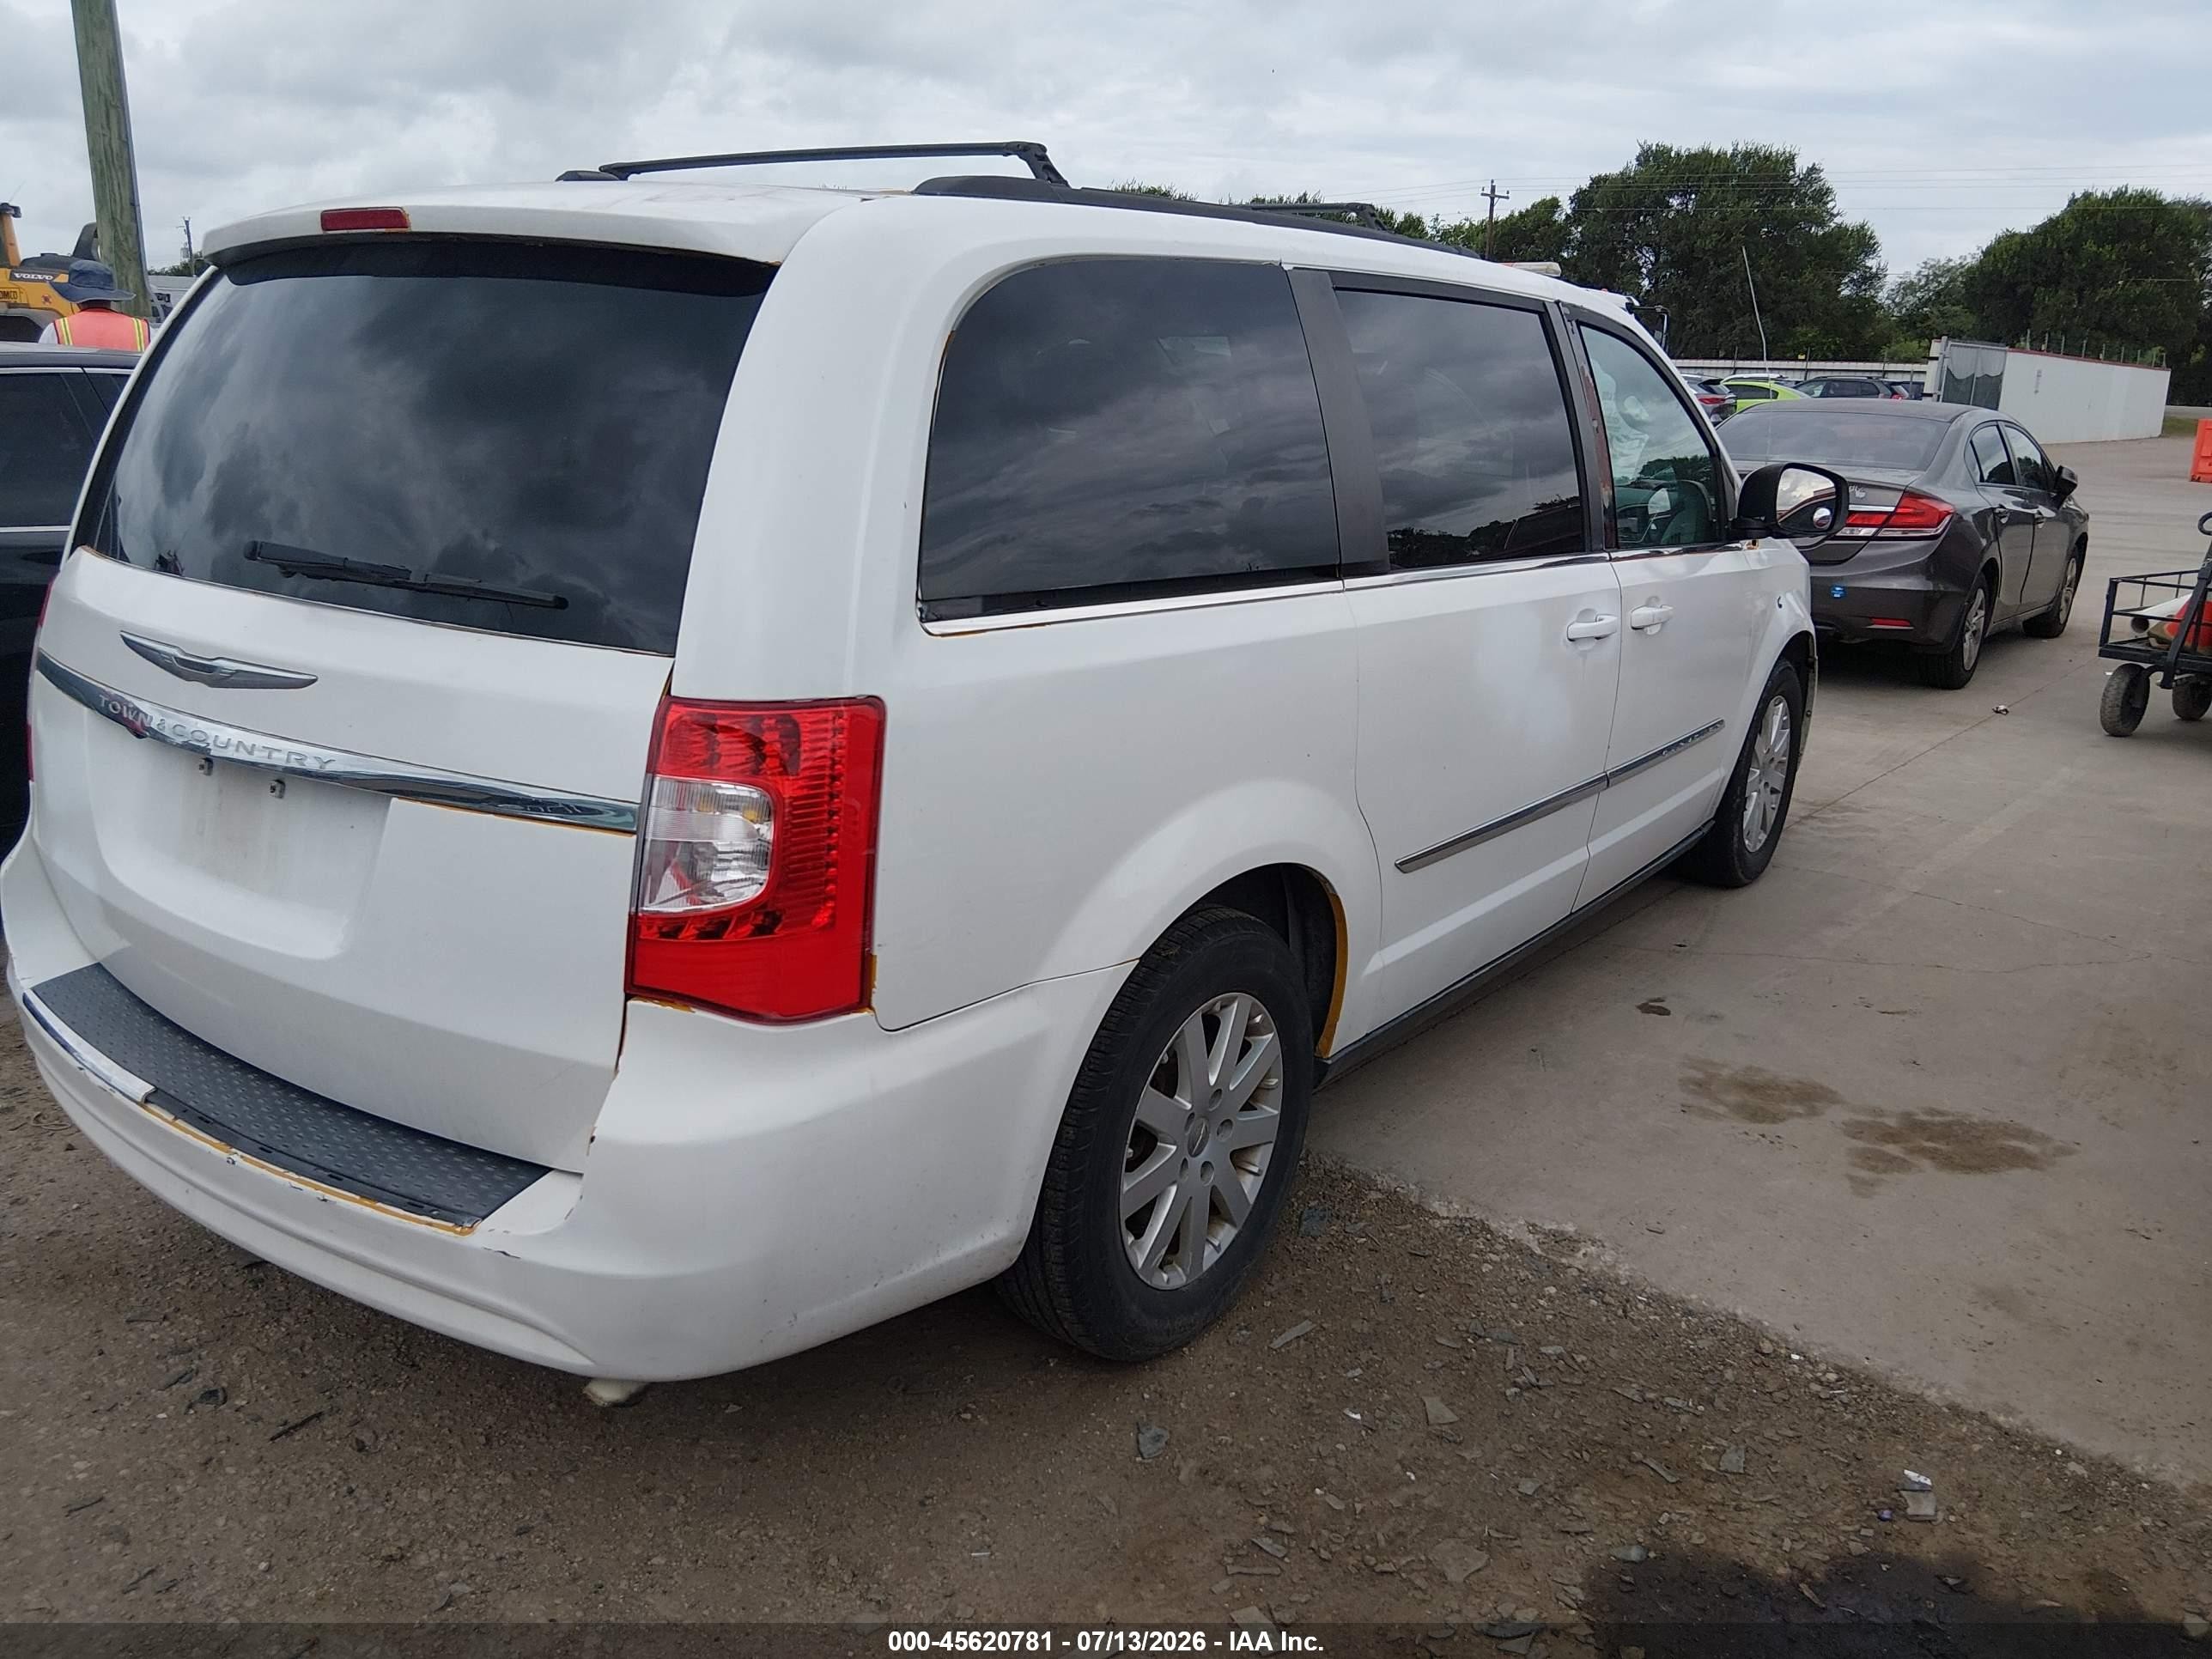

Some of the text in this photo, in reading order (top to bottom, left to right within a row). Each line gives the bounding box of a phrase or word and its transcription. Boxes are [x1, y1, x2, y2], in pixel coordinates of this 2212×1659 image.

[14, 272, 54, 281] VOLVO
[99, 694, 153, 728] TOWN
[171, 723, 336, 770] COUNTRY
